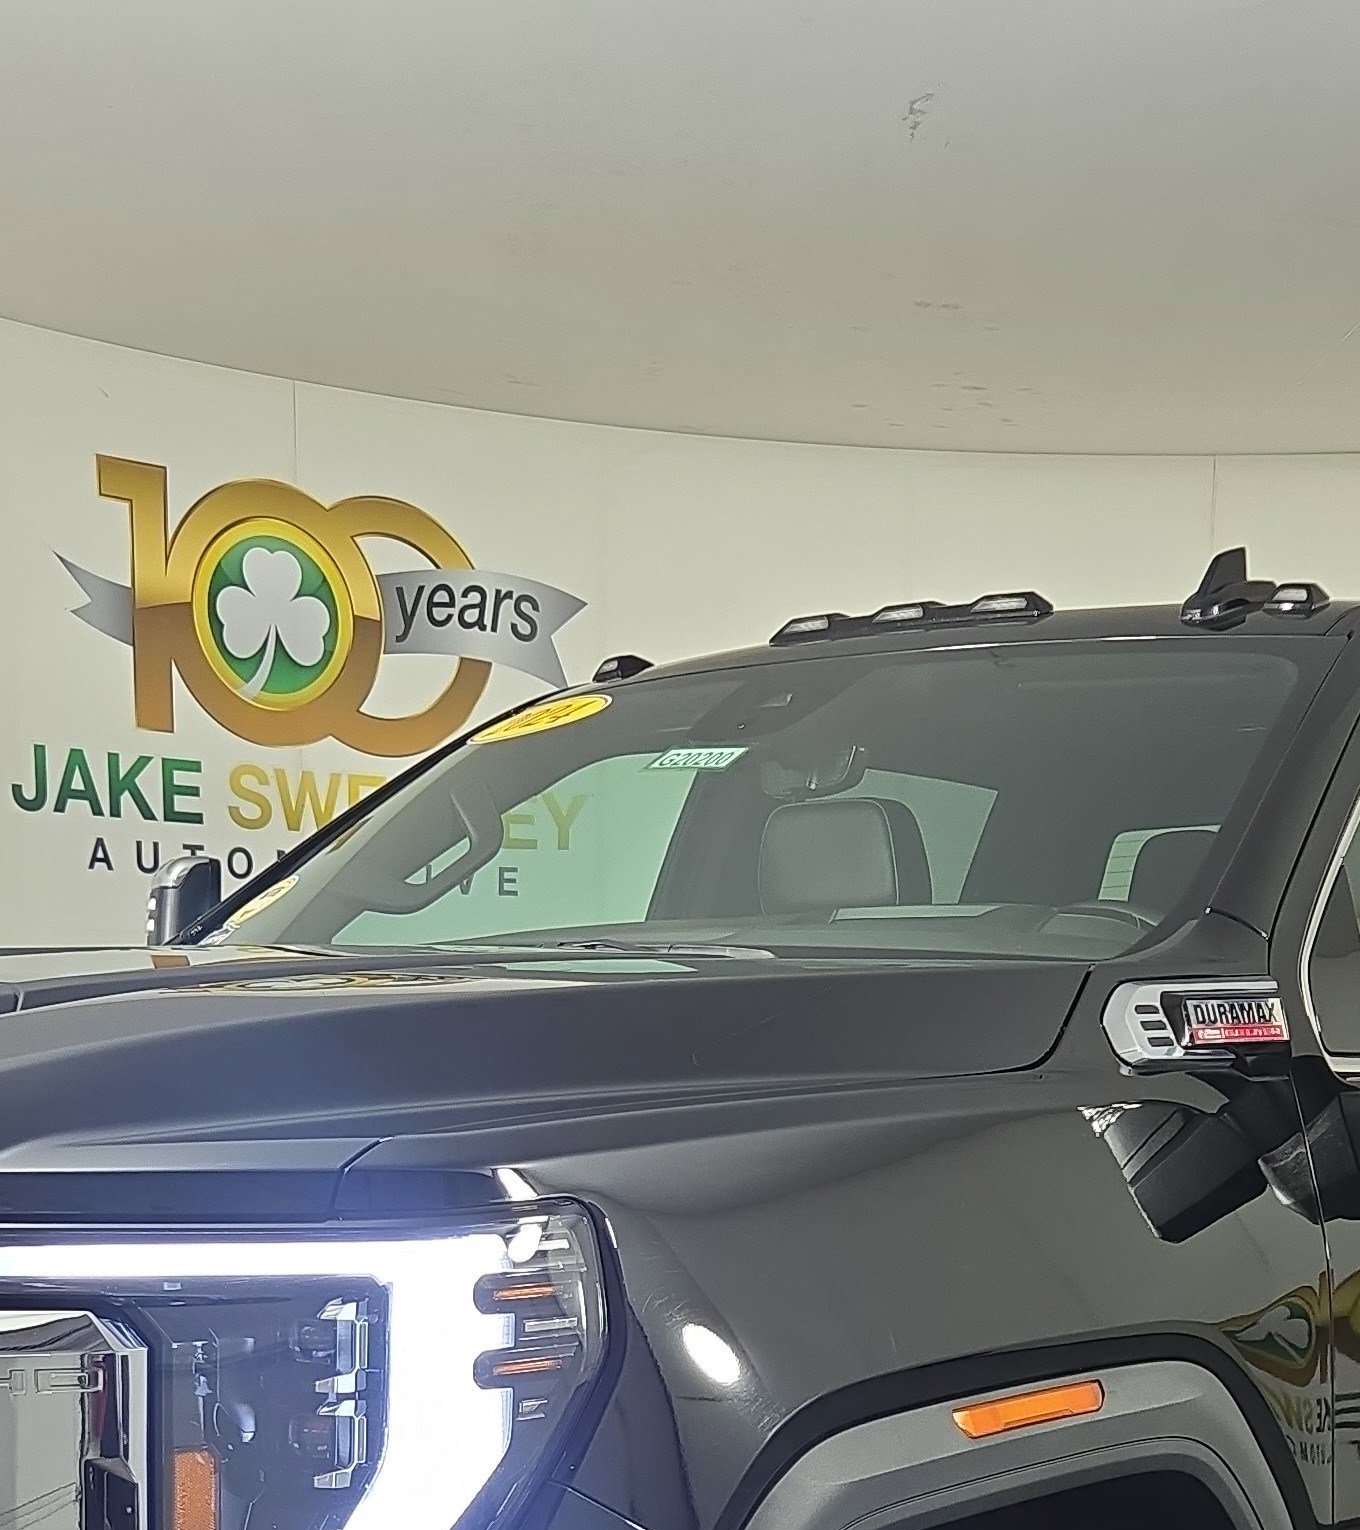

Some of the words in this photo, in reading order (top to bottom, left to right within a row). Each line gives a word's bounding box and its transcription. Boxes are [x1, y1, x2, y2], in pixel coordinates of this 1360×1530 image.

[394, 579, 541, 643] years
[658, 752, 735, 767] G20200
[11, 743, 204, 825] JAKE
[1193, 1000, 1280, 1025] DURAMAX
